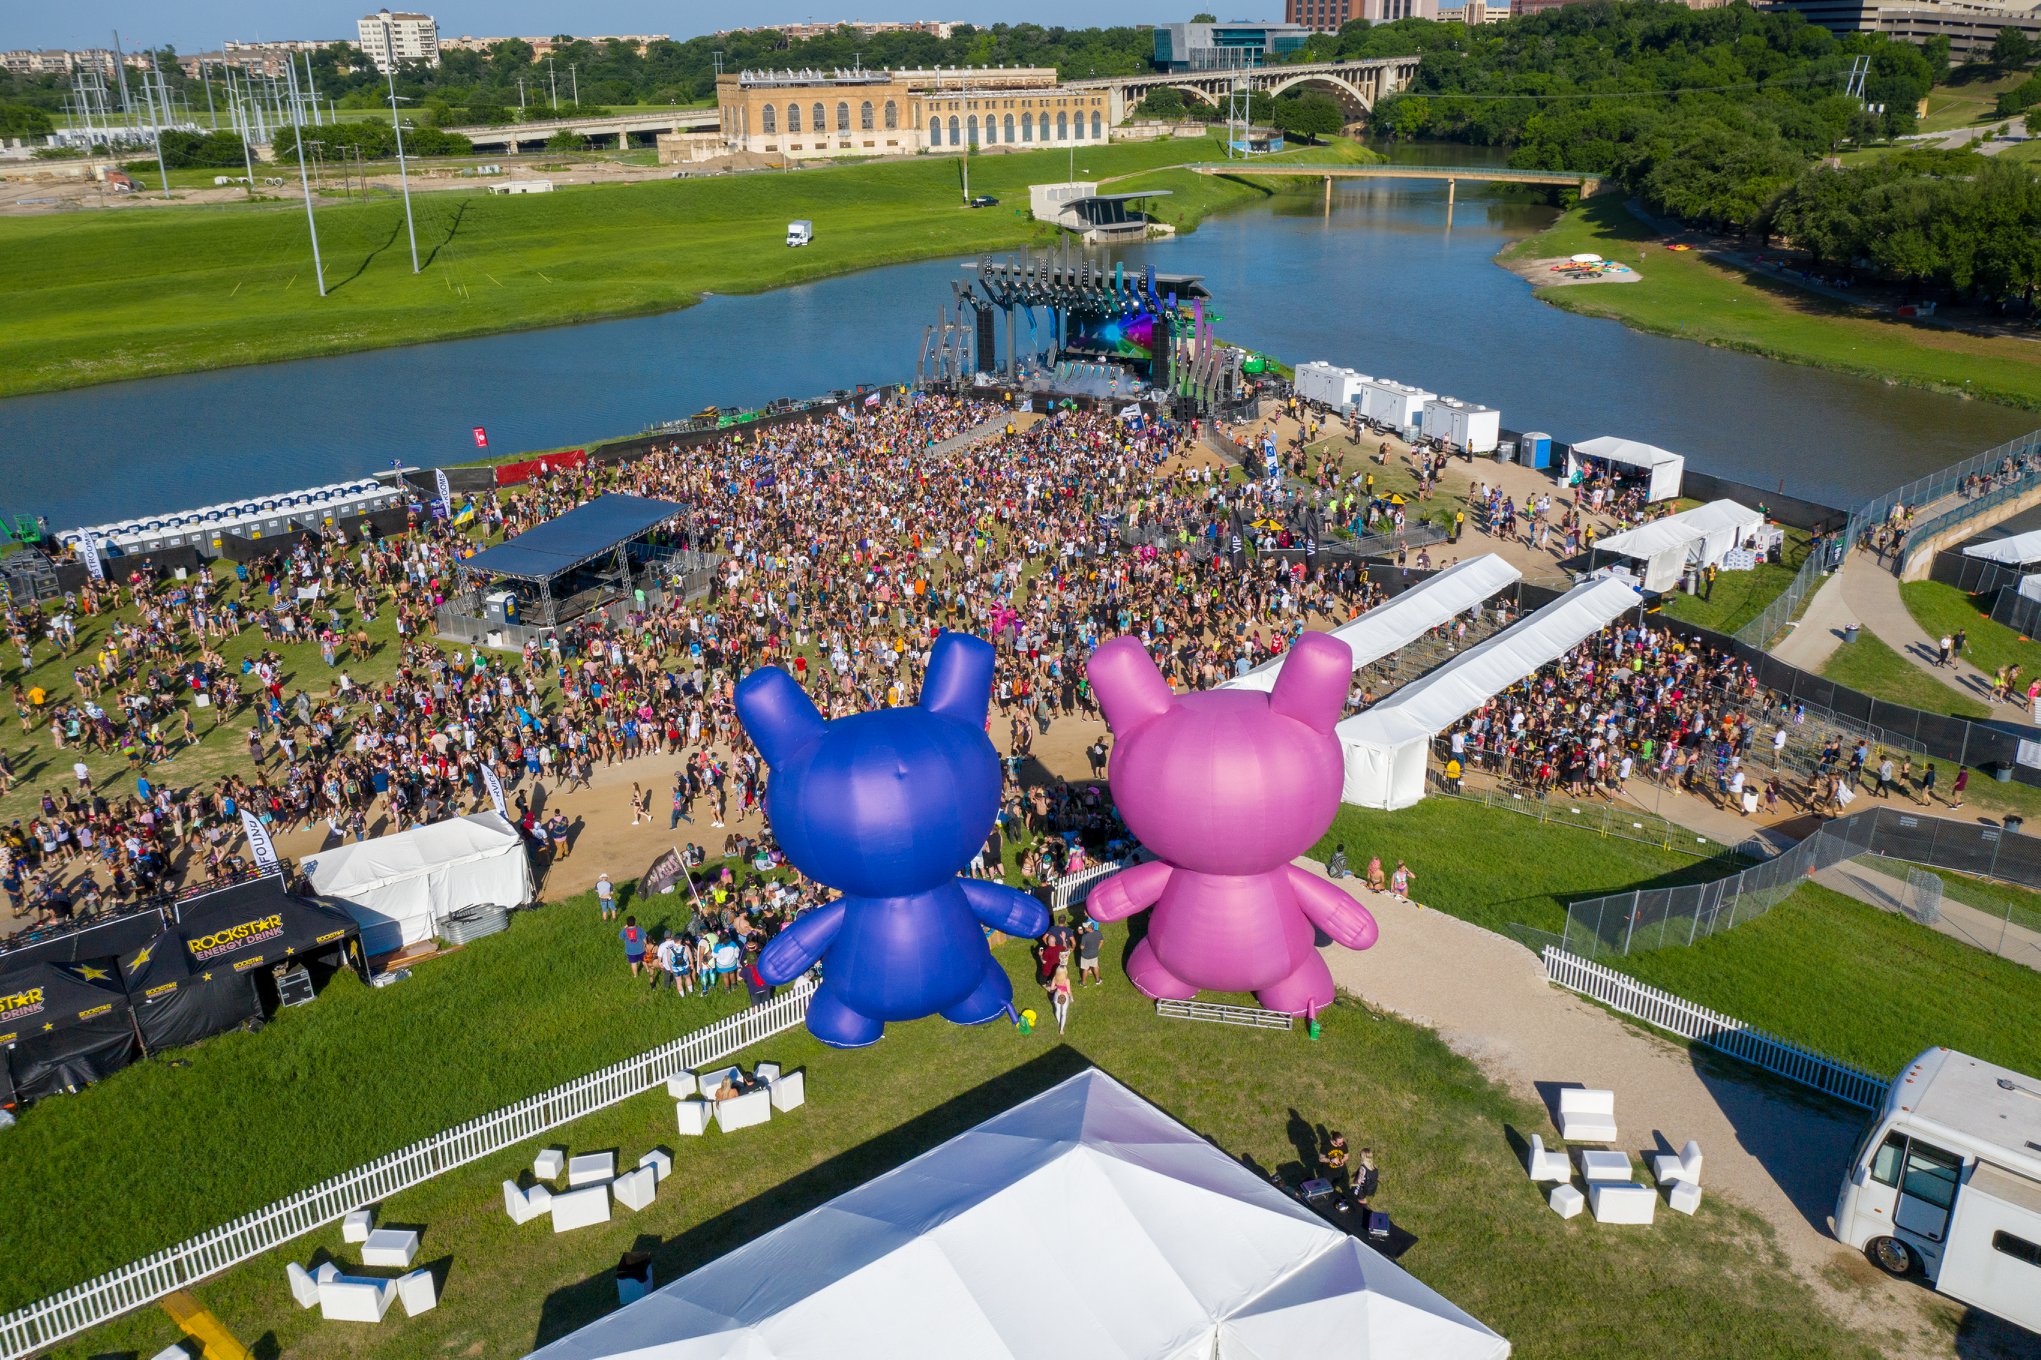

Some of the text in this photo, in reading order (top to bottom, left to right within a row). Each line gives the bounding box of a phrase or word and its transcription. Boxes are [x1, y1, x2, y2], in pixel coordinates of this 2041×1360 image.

[1232, 535, 1241, 554] VIP
[1307, 538, 1316, 556] VIP
[249, 820, 270, 863] FOUND
[188, 914, 282, 953] ROCKSTAR
[197, 926, 282, 959] ENERGY DRINK
[1, 1002, 43, 1020] DRINK
